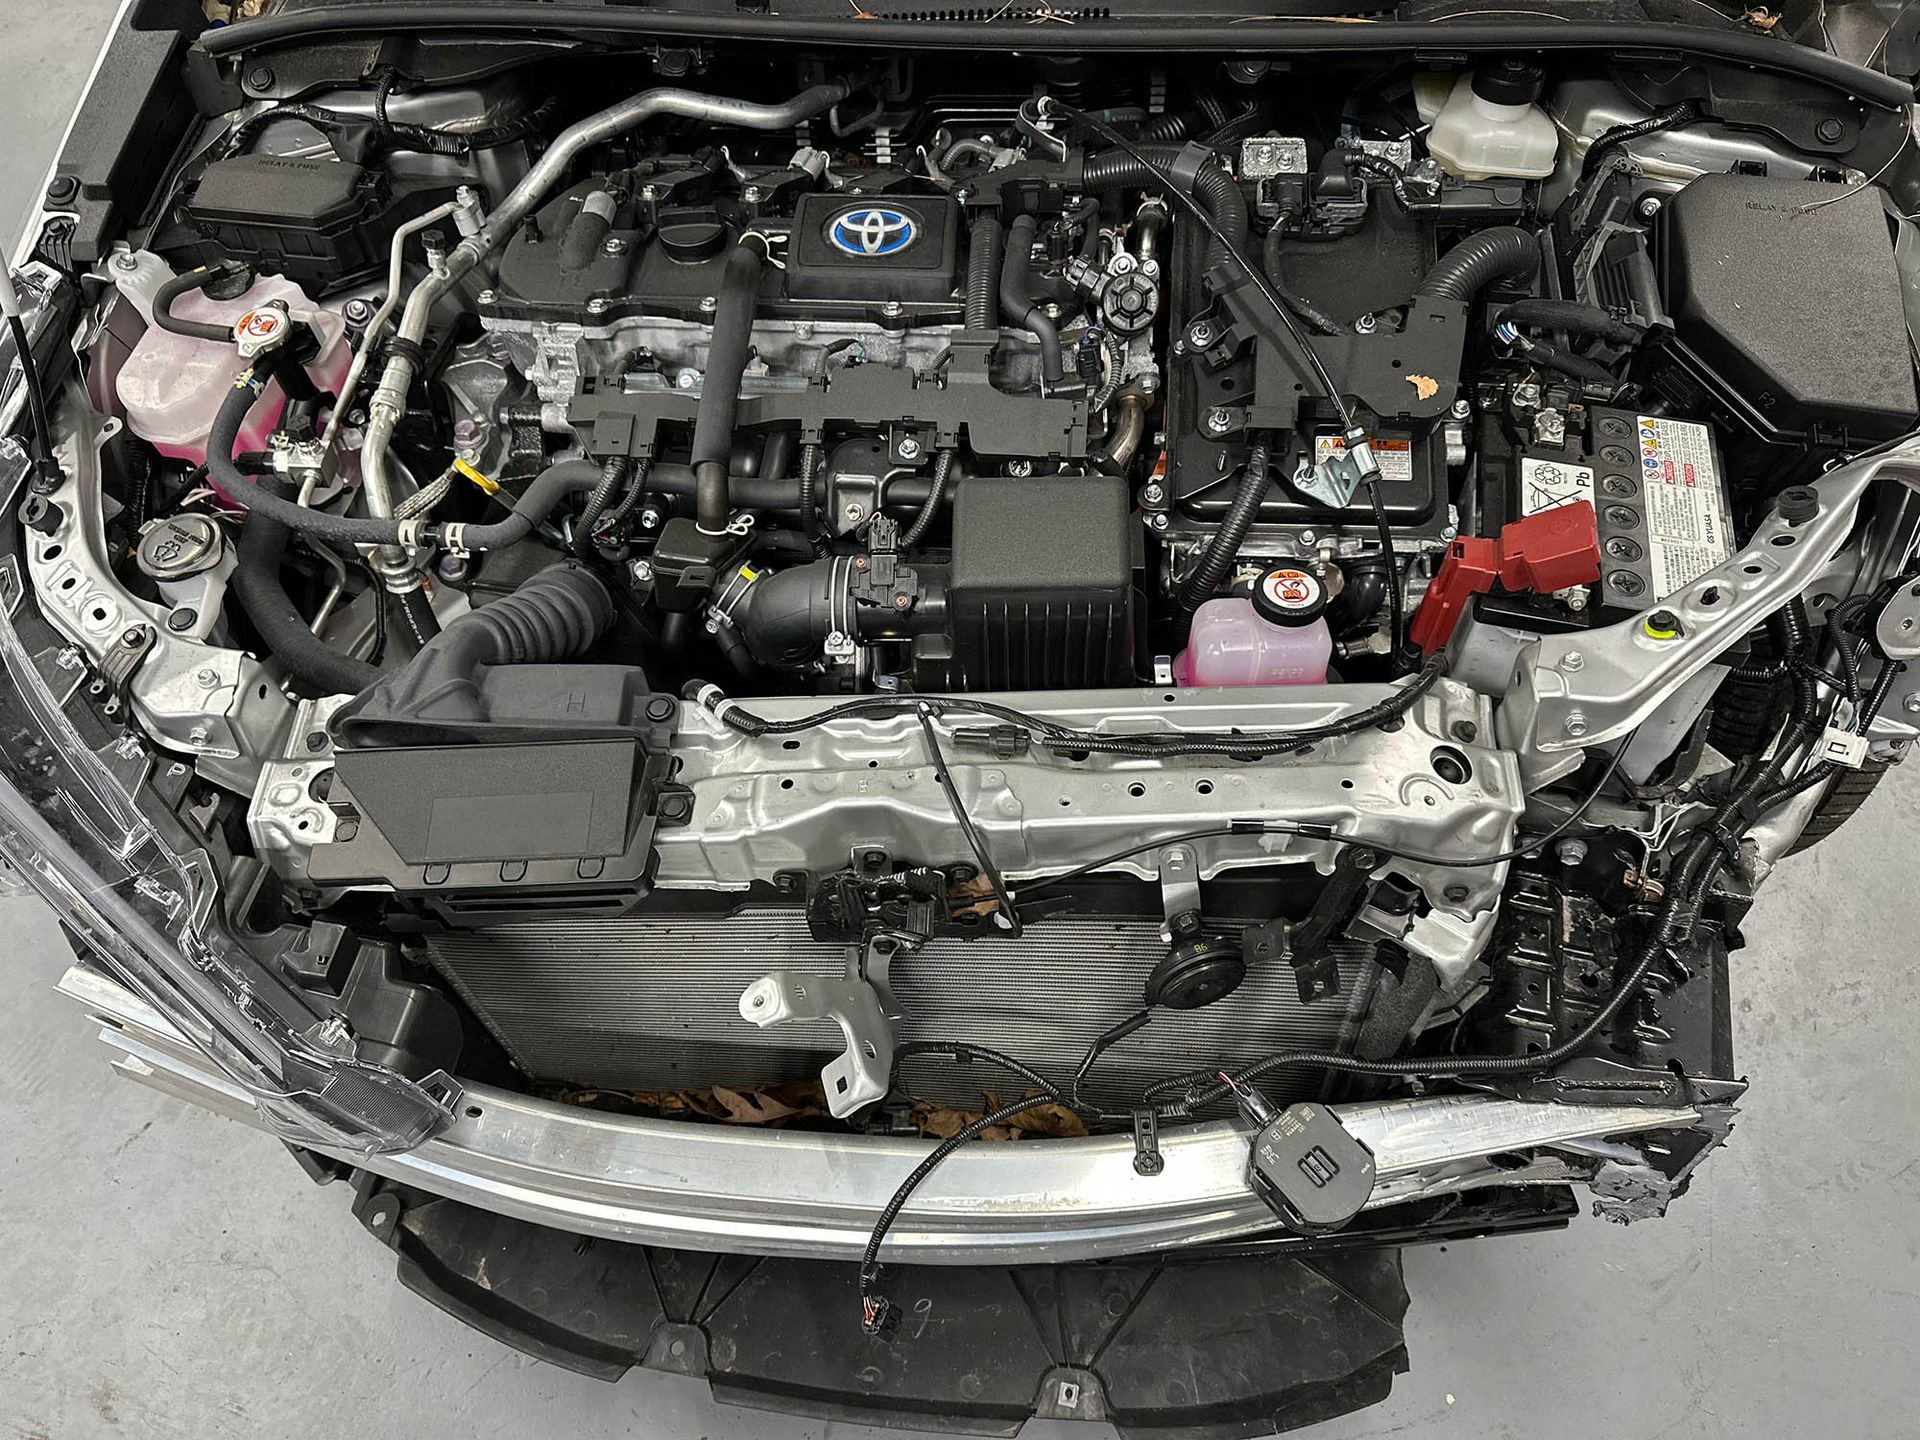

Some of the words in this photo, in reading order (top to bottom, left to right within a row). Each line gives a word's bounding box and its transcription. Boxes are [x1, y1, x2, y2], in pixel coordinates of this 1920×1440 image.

[1758, 391, 1776, 409] F2
[1576, 472, 1590, 488] Pb
[566, 692, 586, 713] H
[913, 1298, 932, 1340] 9
